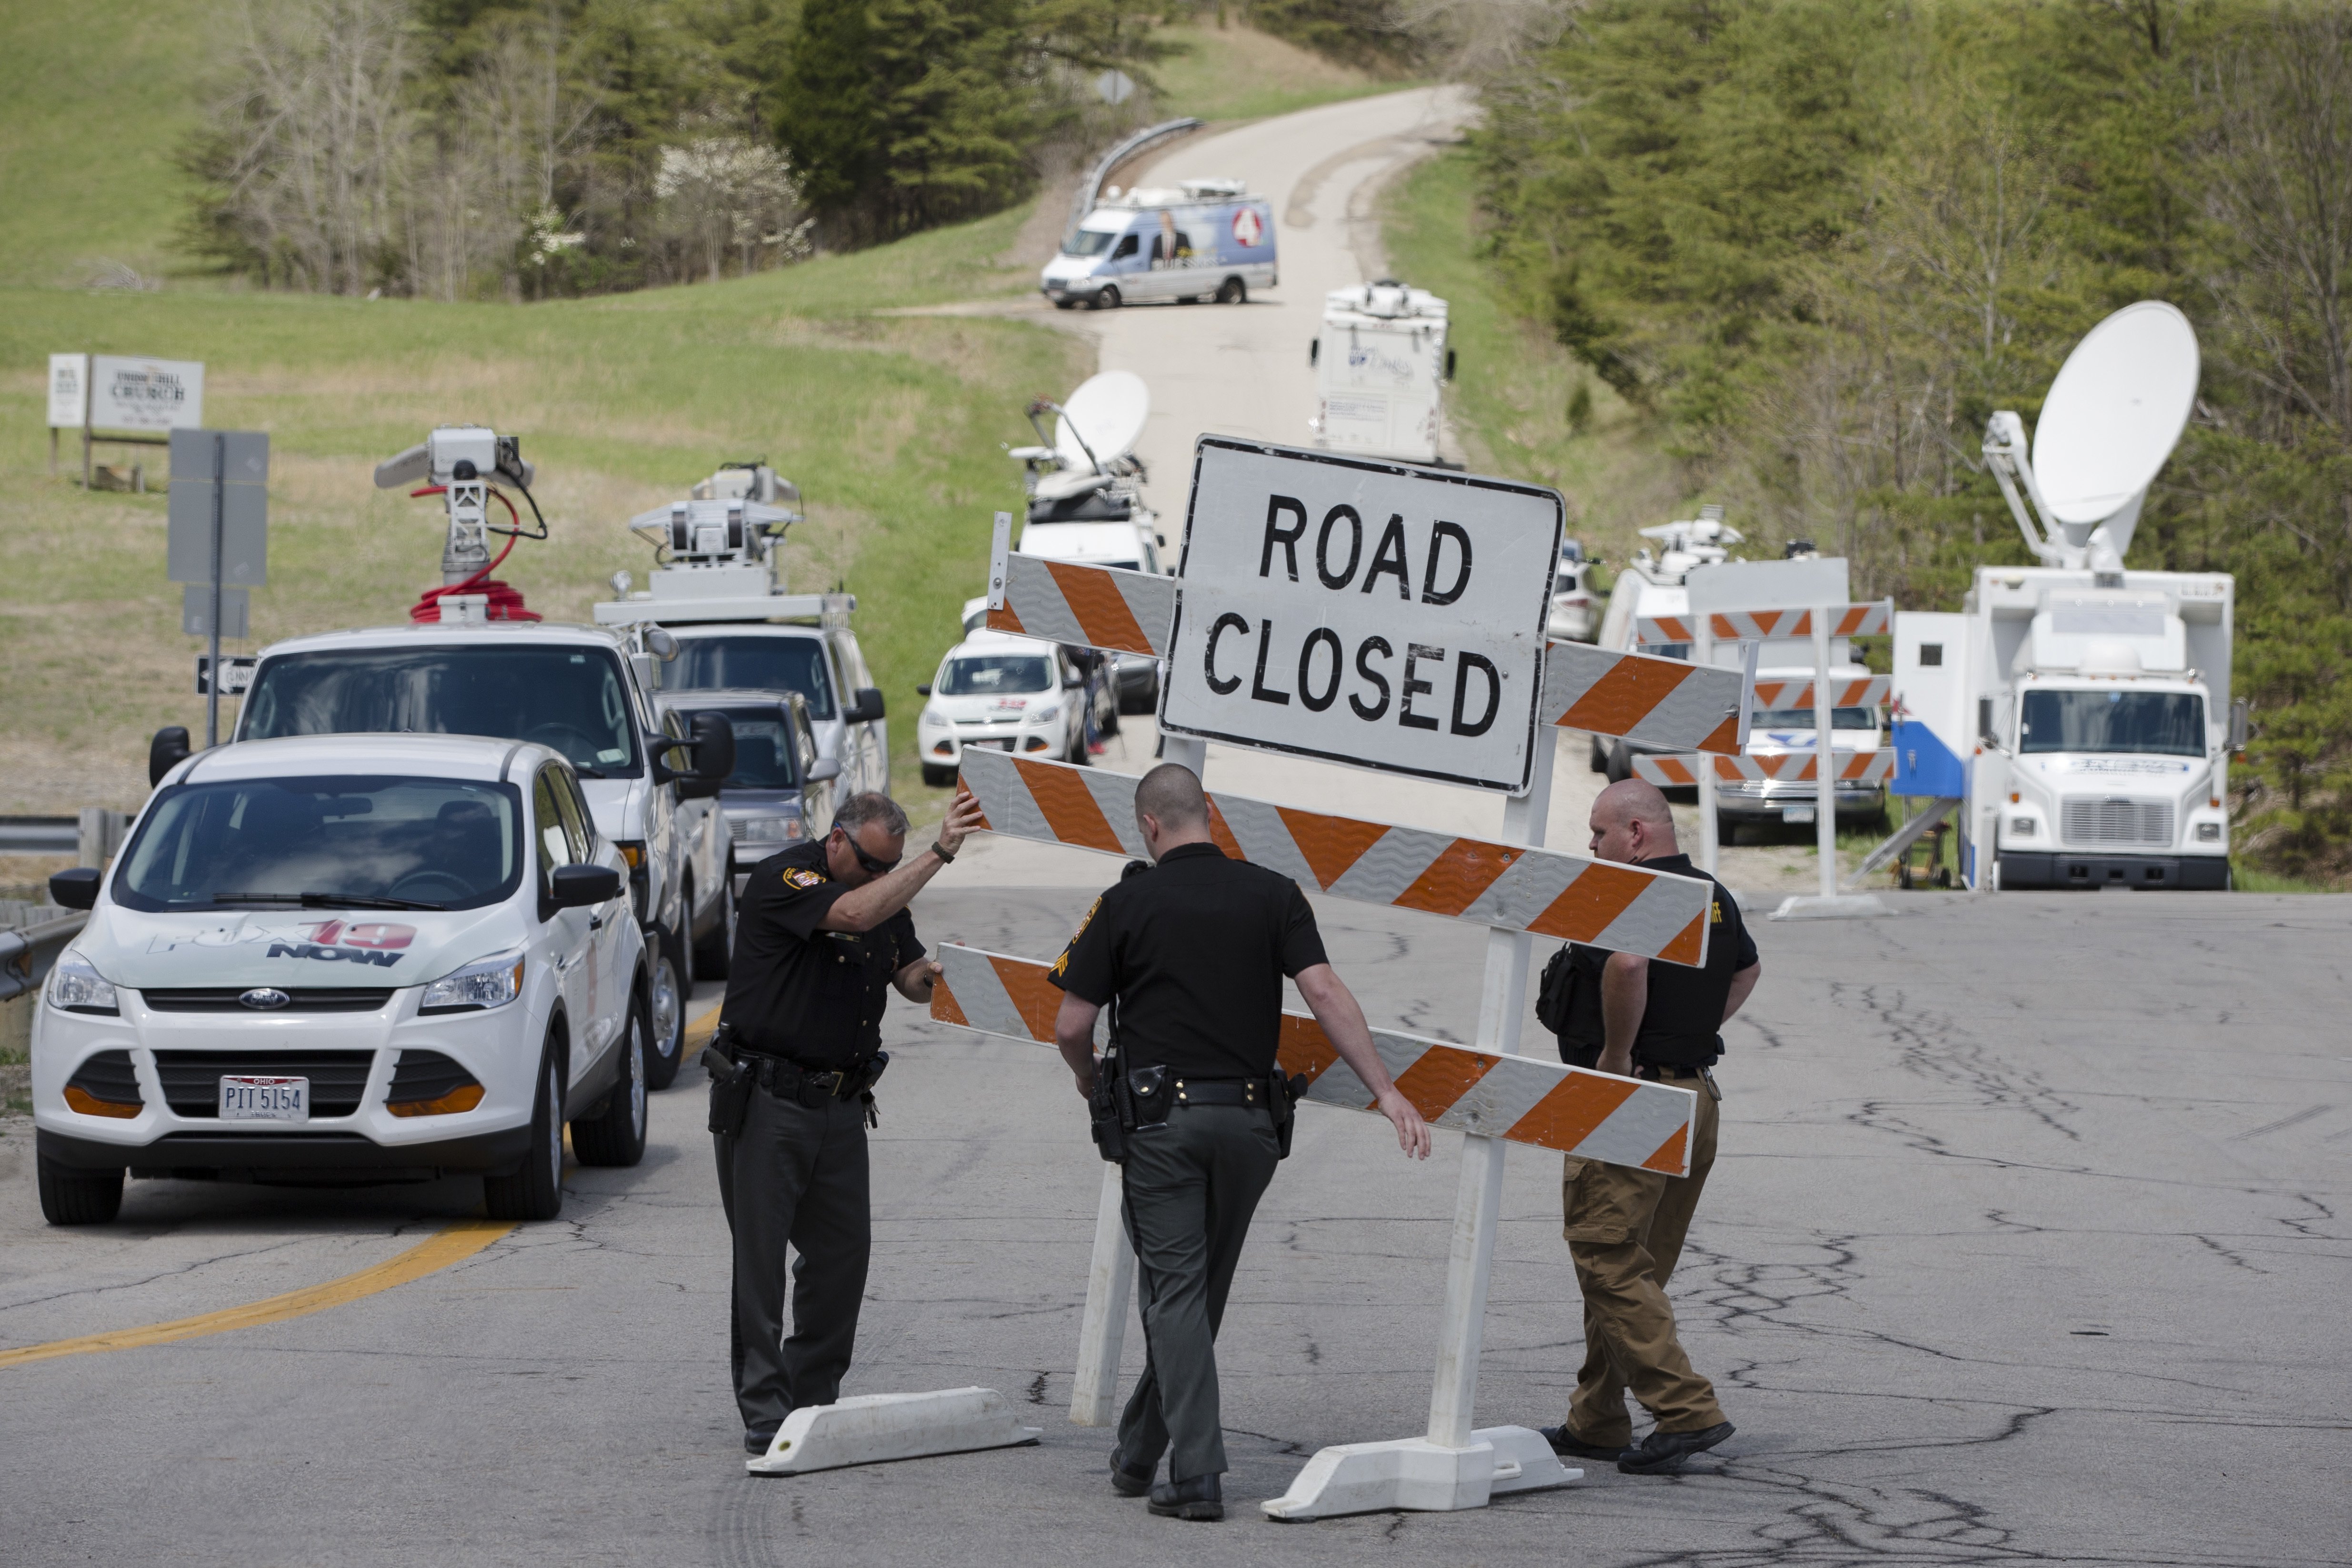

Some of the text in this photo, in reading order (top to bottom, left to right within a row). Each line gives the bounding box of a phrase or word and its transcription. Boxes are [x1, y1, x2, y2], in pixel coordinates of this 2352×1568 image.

[1259, 494, 1472, 607] ROAD
[1204, 612, 1501, 738] CLOSED
[266, 944, 406, 968] NOW
[226, 1086, 301, 1110] PIT 5154
